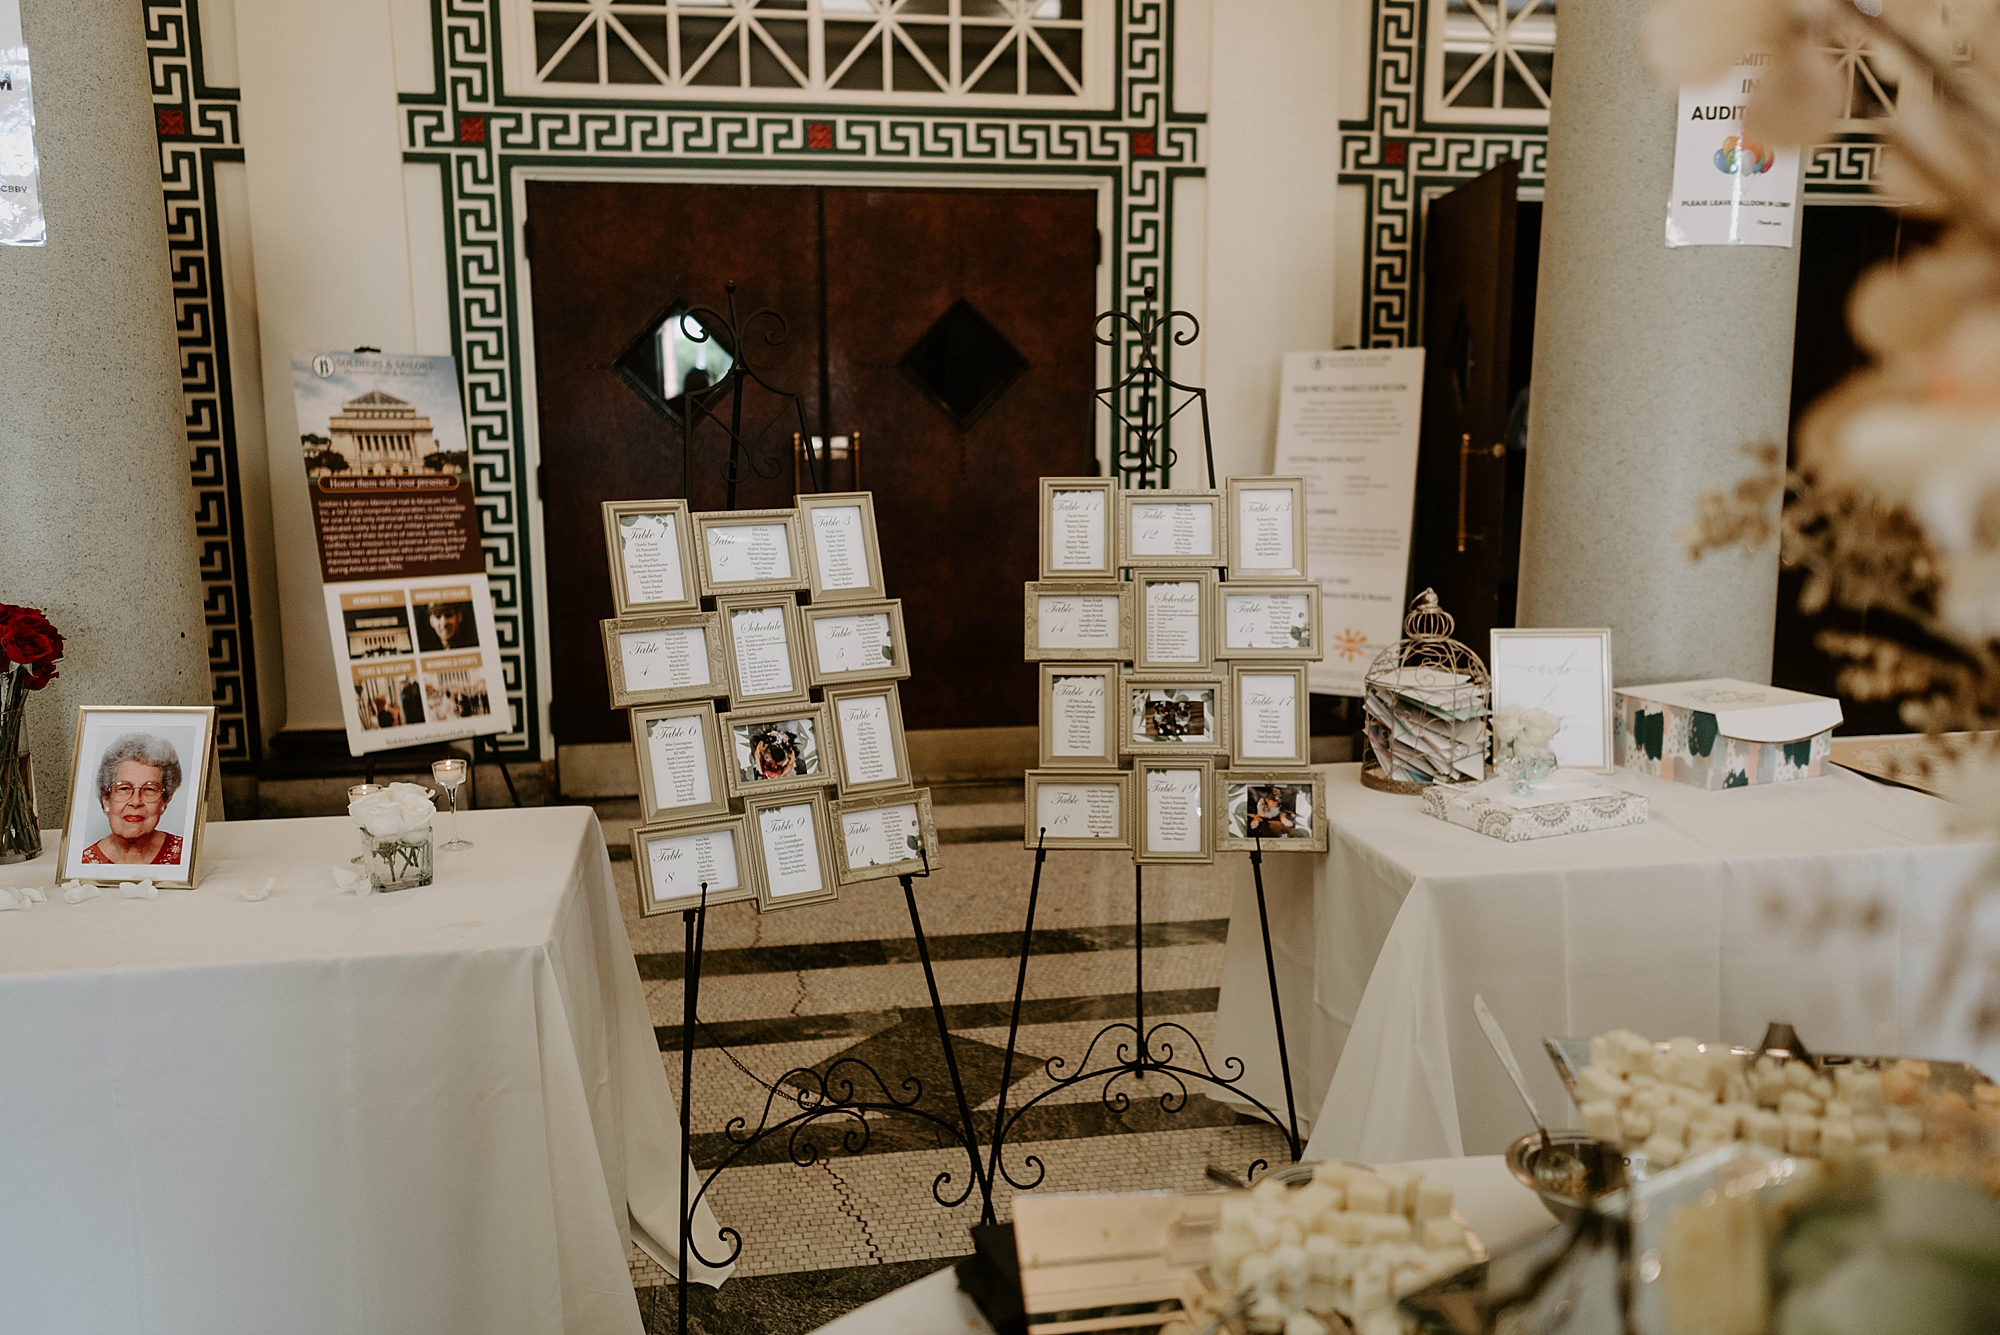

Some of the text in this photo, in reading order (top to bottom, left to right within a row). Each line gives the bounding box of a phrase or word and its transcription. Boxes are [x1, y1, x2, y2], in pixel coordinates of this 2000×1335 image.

[1691, 105, 1747, 120] AUDIT
[330, 478, 355, 488] Honor
[357, 478, 377, 488] them
[379, 478, 396, 488] with
[398, 479, 415, 489] your
[1053, 500, 1080, 511] Table
[1242, 501, 1270, 513] Table
[1137, 507, 1165, 520] Table
[815, 515, 840, 527] Table
[626, 528, 654, 539] Table
[709, 532, 735, 545] Table
[1154, 592, 1196, 603] Schedule
[1045, 601, 1073, 613] Table
[1234, 601, 1262, 613] Table
[740, 620, 782, 633] Schedule
[826, 625, 852, 639] Table
[629, 641, 659, 655] Table
[1056, 684, 1084, 696] Table
[1245, 693, 1273, 705] Table
[845, 708, 870, 721] Table
[656, 726, 684, 739] Table
[1148, 781, 1176, 792] Table
[1051, 792, 1079, 805] Table
[765, 818, 793, 833] Table
[844, 822, 870, 836] Table
[653, 847, 683, 863] Table
